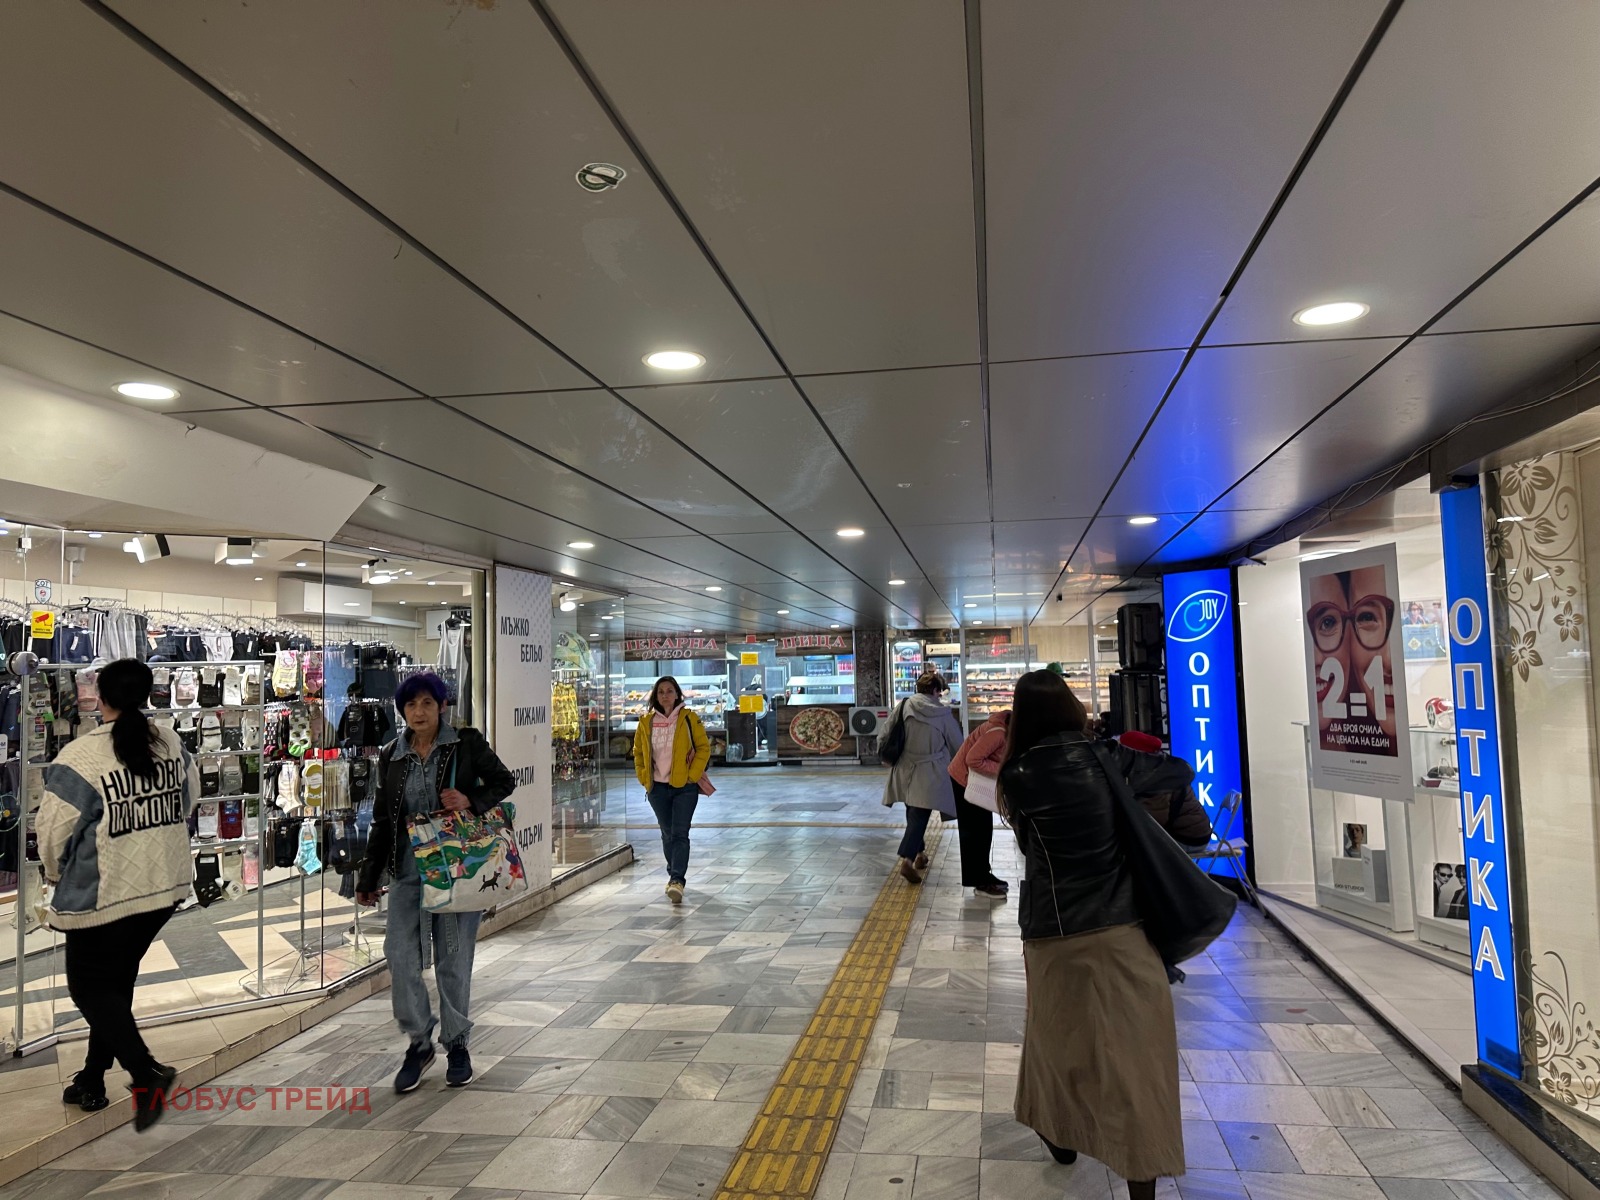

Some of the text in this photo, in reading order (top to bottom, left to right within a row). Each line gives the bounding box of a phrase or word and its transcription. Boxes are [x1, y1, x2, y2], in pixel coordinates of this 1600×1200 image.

[501, 616, 529, 636] МЪЖКО
[618, 637, 719, 651] ПЕКАРНА
[781, 635, 847, 649] ПИЦА
[520, 644, 543, 662] БЕЛЬО
[514, 705, 546, 727] ПИЖАМИ
[1330, 723, 1383, 735] ДВА БРОЯ ОЧИЛА
[1188, 651, 1217, 841] ОПТИК
[1327, 734, 1390, 748] НА ЦЕНАТА НА ЕДИН
[1450, 597, 1506, 981] ОПТИКА
[516, 822, 543, 851] АДЪРИ
